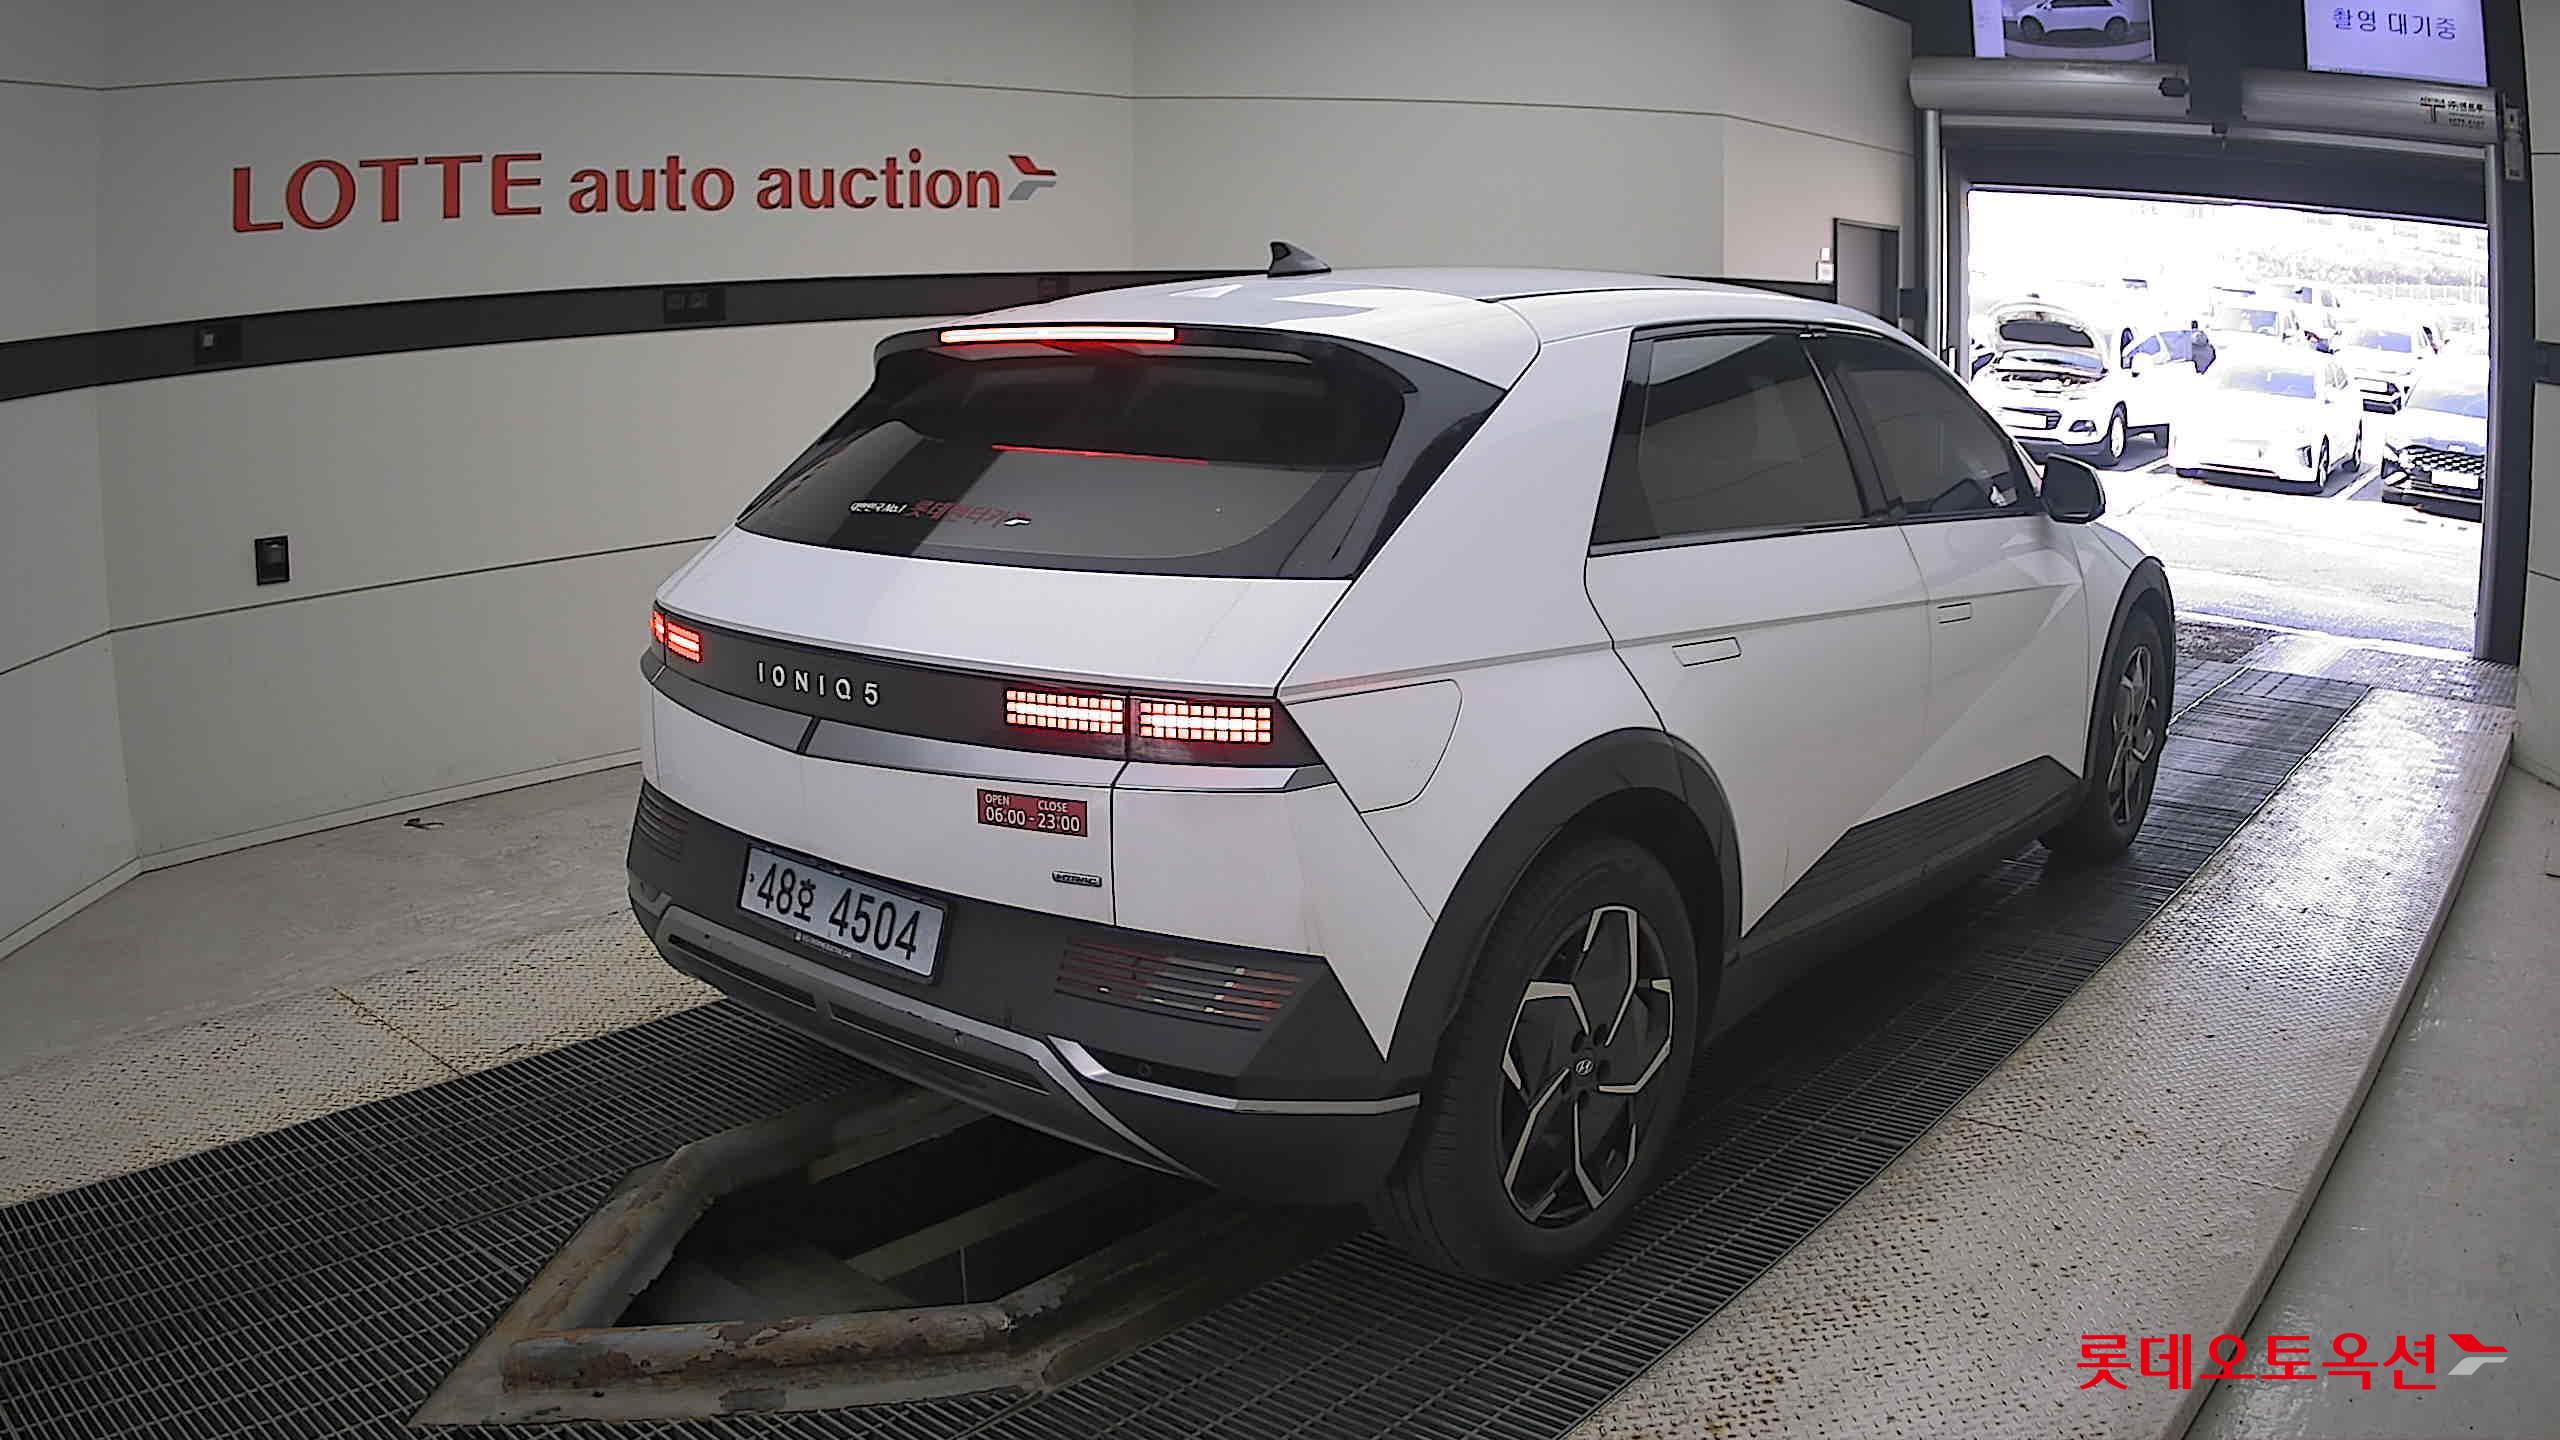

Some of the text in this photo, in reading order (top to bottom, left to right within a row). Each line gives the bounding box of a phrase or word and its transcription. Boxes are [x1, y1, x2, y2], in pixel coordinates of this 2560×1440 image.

[2388, 12, 2457, 40] 대기중
[232, 148, 1003, 233] LOTTE auto auction
[757, 661, 880, 706] IONIQ 5
[984, 793, 1069, 813] OPEN CLOSE
[985, 806, 1027, 827] 06:00
[1037, 812, 1081, 832] 23:00
[757, 862, 921, 961] 48호 4504
